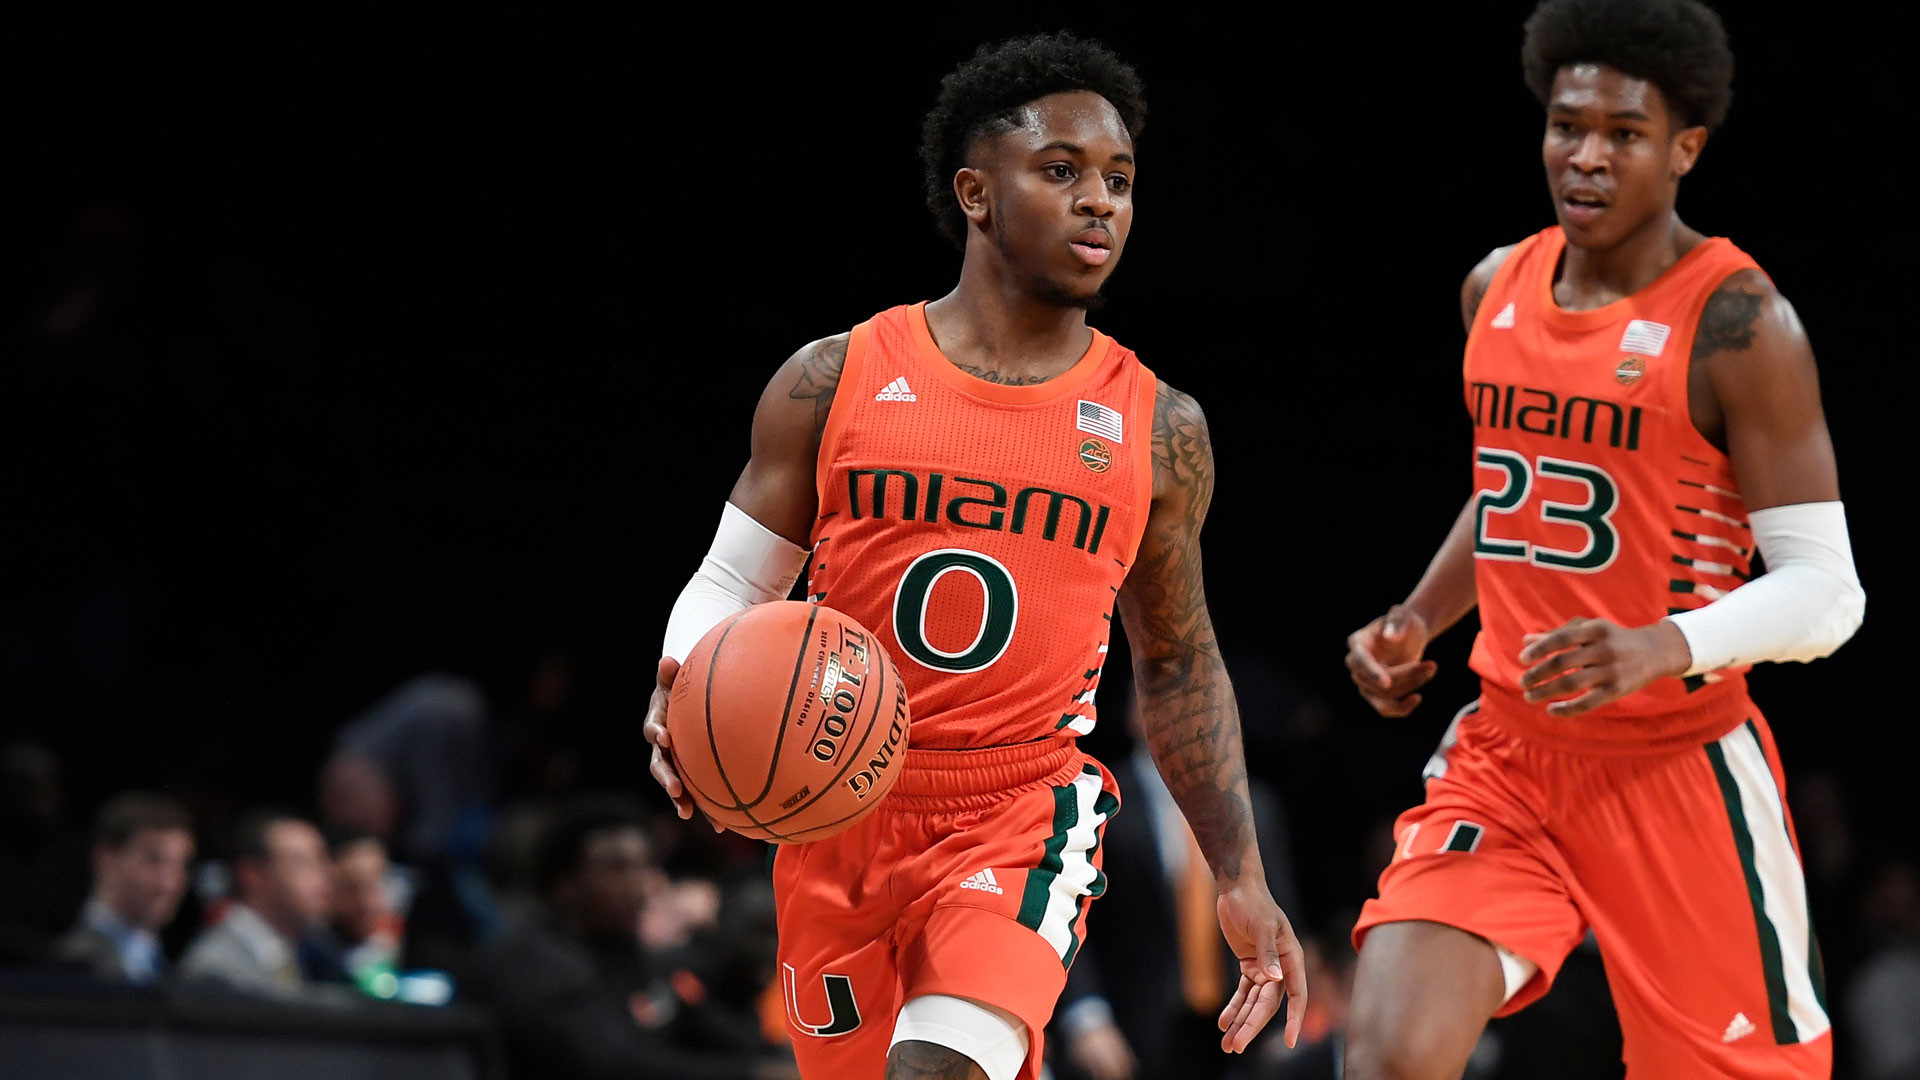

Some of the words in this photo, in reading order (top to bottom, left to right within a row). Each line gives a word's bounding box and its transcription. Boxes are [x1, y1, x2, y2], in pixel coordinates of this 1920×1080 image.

[875, 390, 917, 403] adidas
[1083, 447, 1111, 461] ACC
[1473, 446, 1620, 574] 23
[820, 630, 828, 649] DEEP
[893, 548, 1018, 674] 0
[796, 692, 815, 727] DESIGN
[813, 626, 867, 763] TF-1000
[819, 651, 841, 710] LEGACY
[848, 667, 907, 800] ALDING
[960, 880, 1003, 895] adidas
[783, 962, 862, 1037] U
